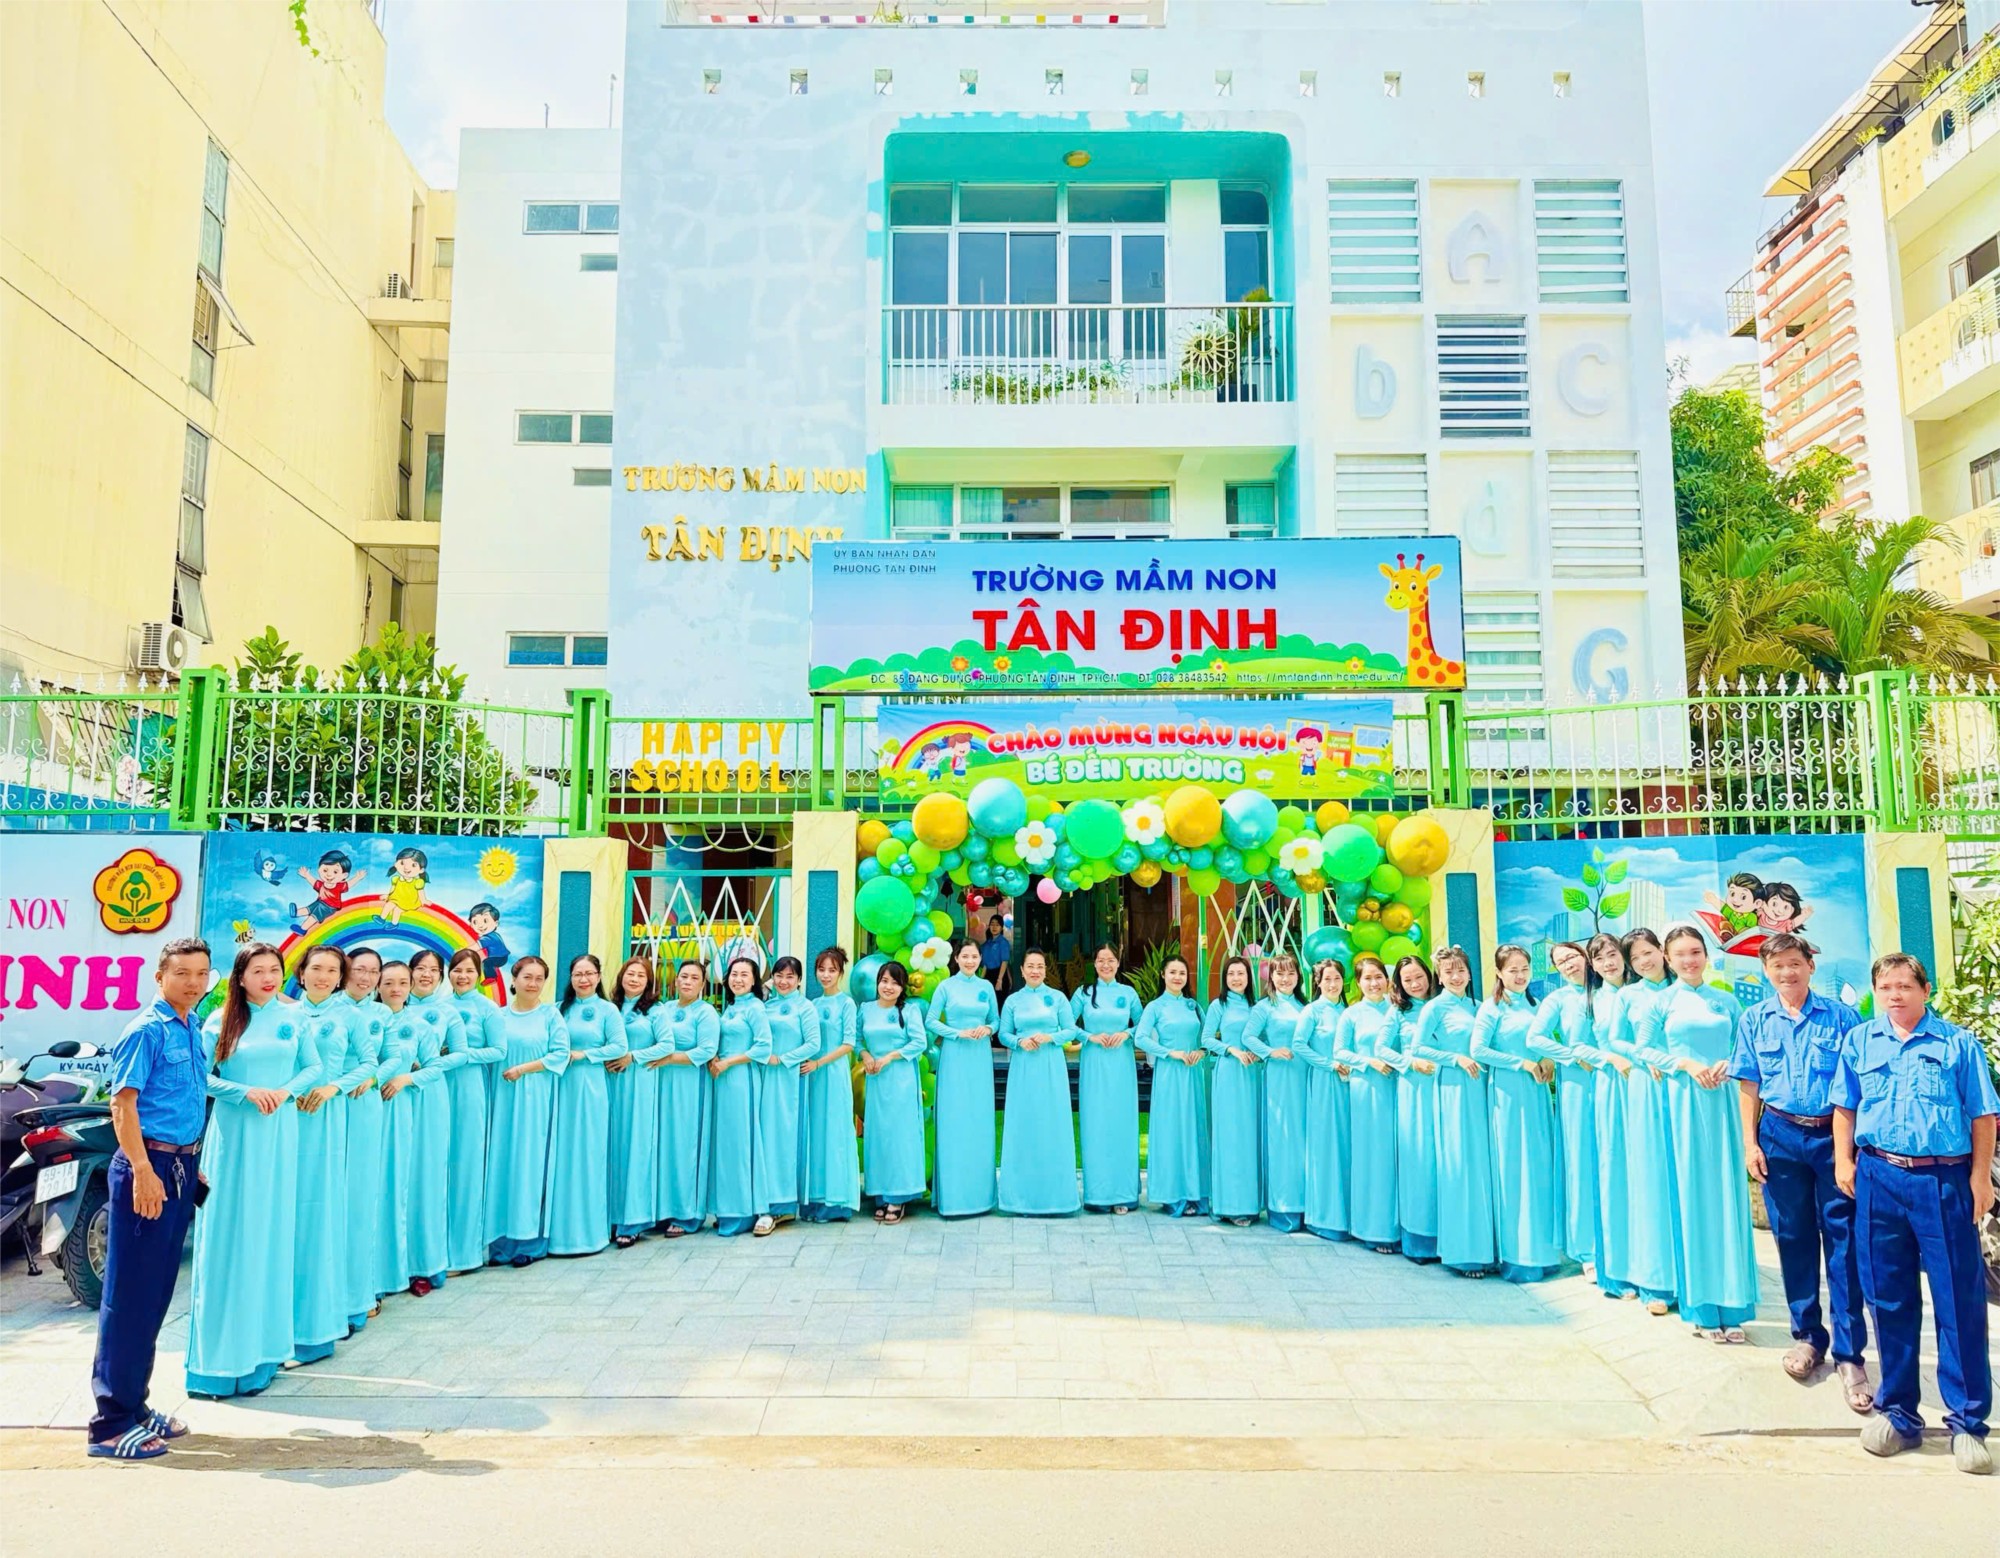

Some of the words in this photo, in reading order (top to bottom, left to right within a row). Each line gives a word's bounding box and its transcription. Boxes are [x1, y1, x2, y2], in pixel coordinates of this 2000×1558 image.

[1447, 210, 1507, 284] A
[1353, 343, 1396, 420] b
[1558, 342, 1611, 416] C
[812, 467, 867, 494] NON
[641, 515, 727, 561] TÂN
[851, 550, 874, 558] BAN
[972, 563, 1104, 591] TRƯỜNG
[1116, 558, 1193, 591] MẦM
[1205, 568, 1276, 590] NON
[972, 598, 1096, 651] TÂN
[1120, 608, 1278, 664] ĐỊNH
[1573, 627, 1629, 699] G
[988, 724, 1061, 754] CHÀO
[1068, 717, 1151, 746] MỪNG
[1158, 720, 1232, 747] NGÀY
[1239, 724, 1288, 755] HỘI
[631, 759, 788, 793] SCHOOL
[1027, 756, 1061, 784] BÉ
[1064, 747, 1123, 782] ĐẾN
[1125, 750, 1245, 784] TRƯỜNG
[6, 898, 69, 930] NON
